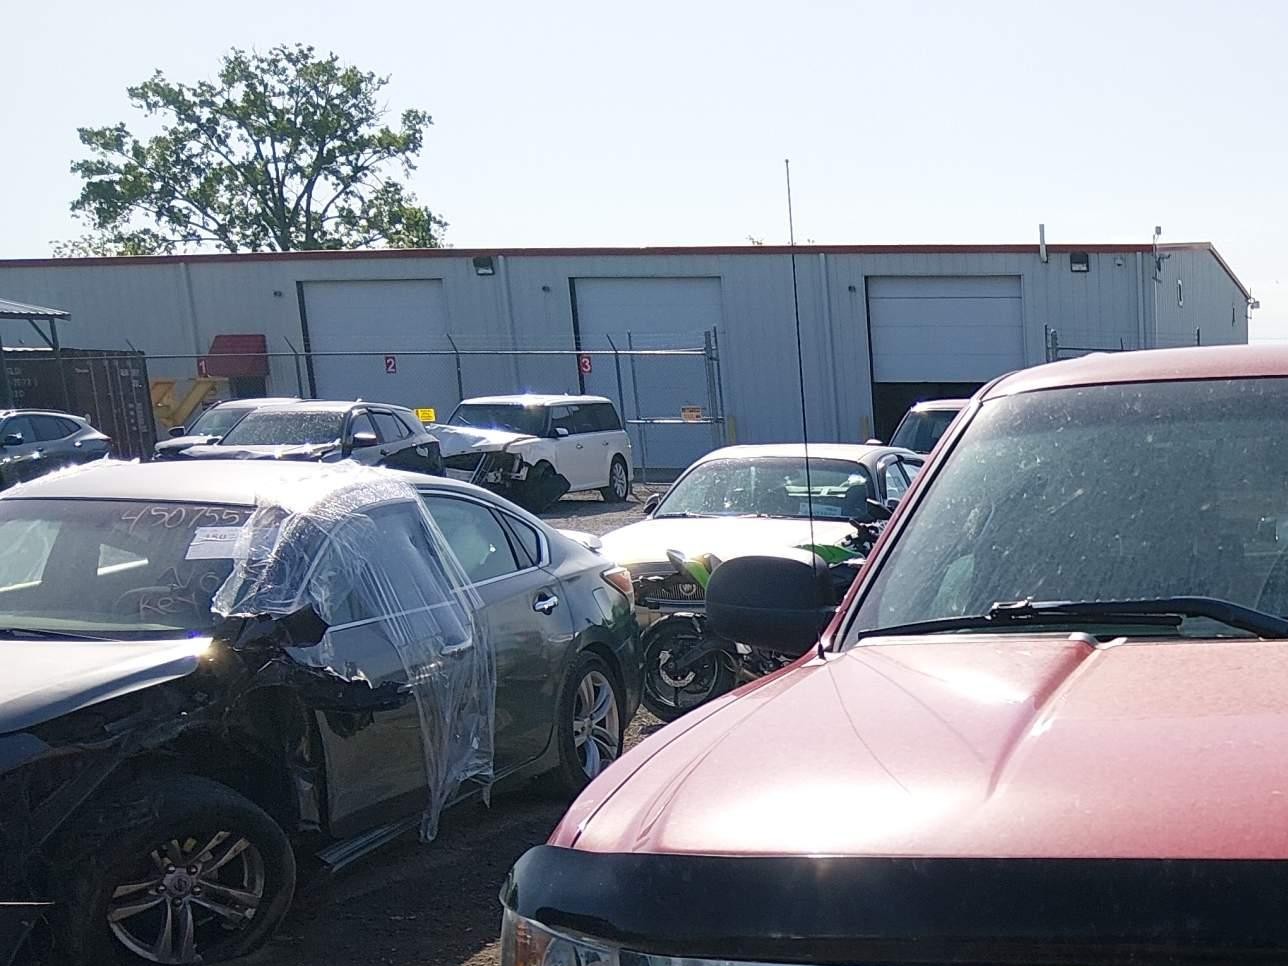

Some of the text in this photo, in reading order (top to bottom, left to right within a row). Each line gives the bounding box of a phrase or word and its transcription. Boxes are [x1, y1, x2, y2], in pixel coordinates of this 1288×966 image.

[199, 360, 207, 374] 1
[386, 358, 396, 372] 2
[581, 358, 591, 372] 3
